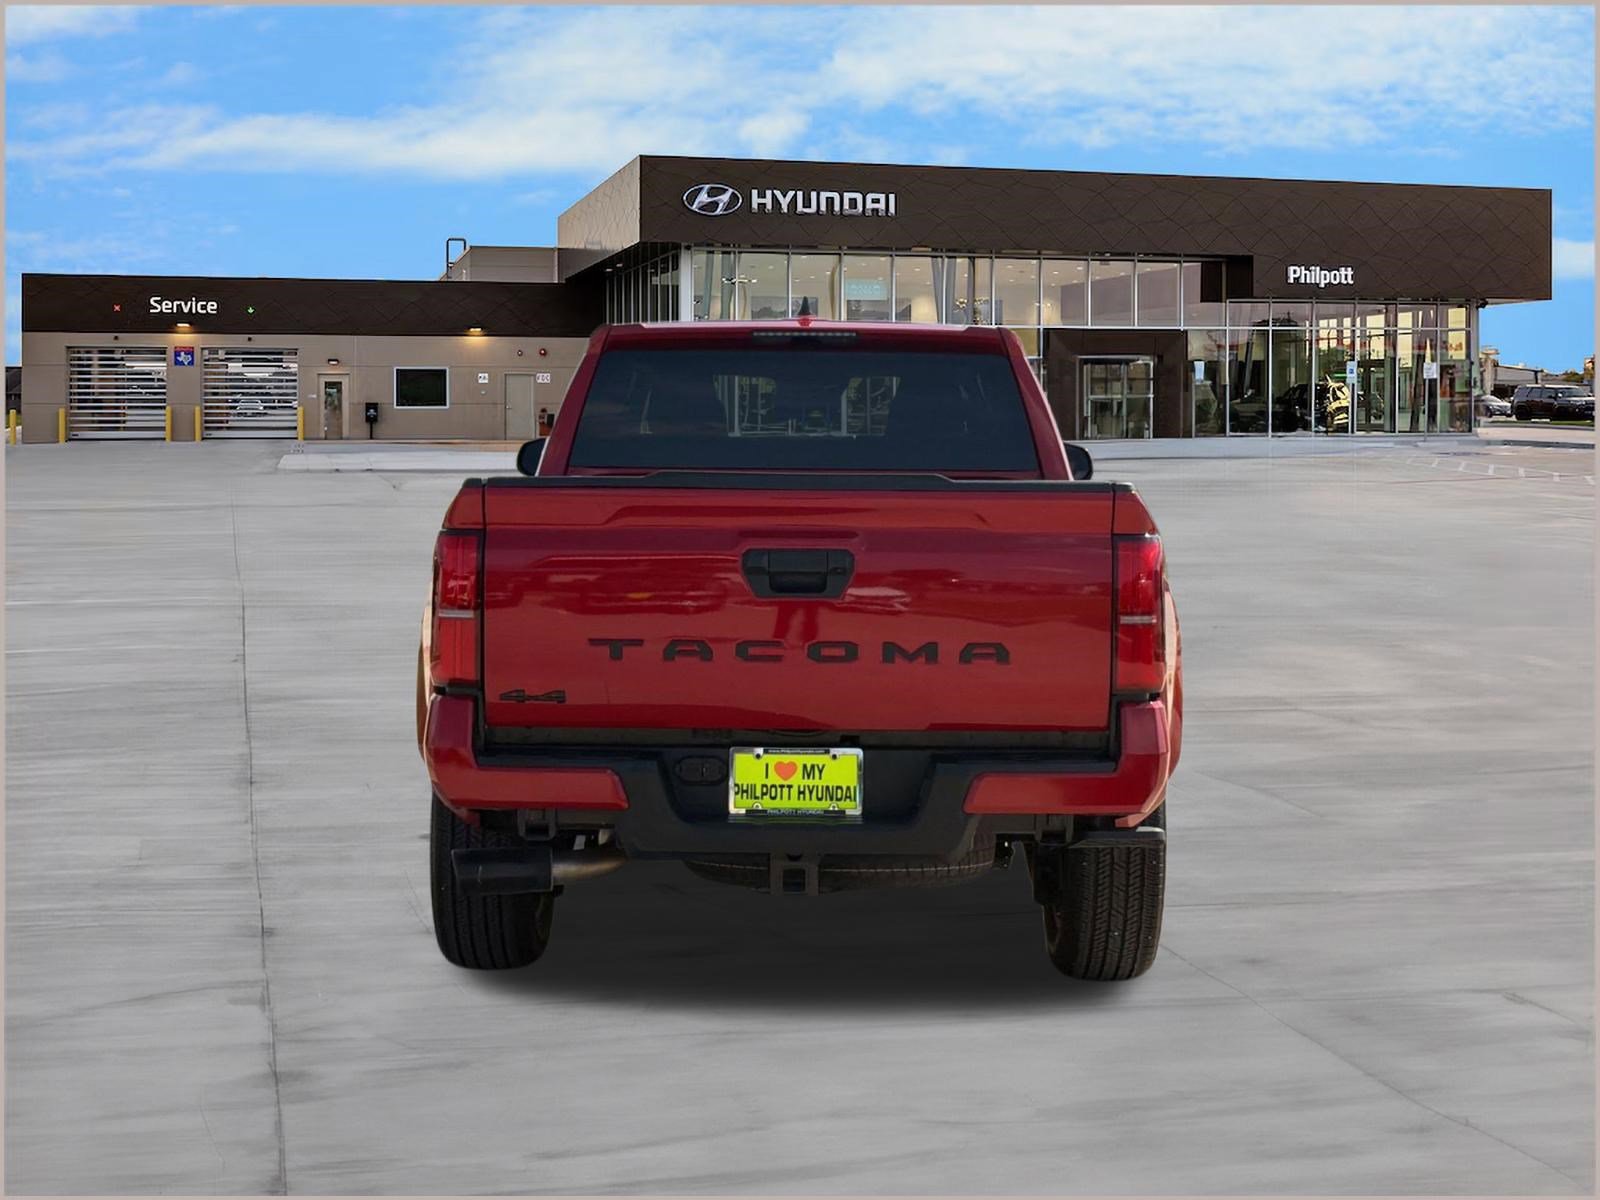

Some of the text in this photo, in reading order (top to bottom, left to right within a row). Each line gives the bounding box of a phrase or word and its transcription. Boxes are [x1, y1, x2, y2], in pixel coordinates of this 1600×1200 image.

[751, 189, 896, 216] HYUNDAI
[1287, 265, 1354, 288] Philpott
[149, 297, 218, 314] Service
[588, 637, 1011, 664] TACOMA
[765, 762, 826, 780] I MY
[734, 783, 857, 803] PHILPOTT HYUNDAI
